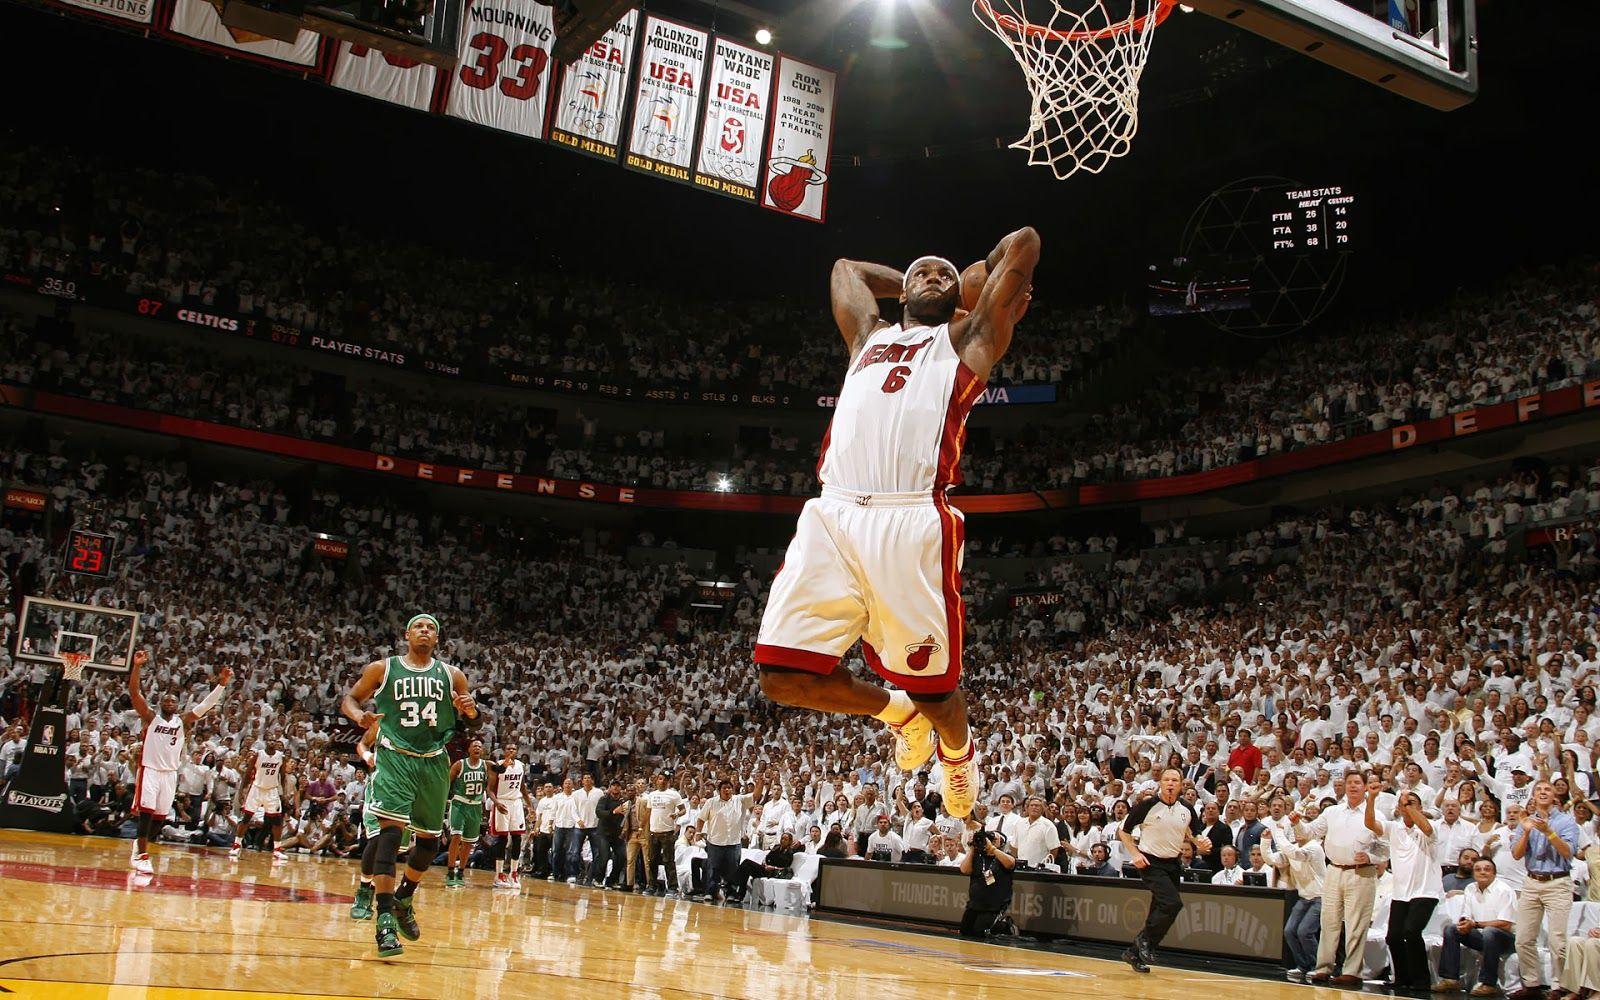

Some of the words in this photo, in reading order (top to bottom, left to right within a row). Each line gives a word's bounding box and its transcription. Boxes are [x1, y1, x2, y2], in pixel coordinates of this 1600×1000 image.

[471, 7, 552, 41] MOURNING
[655, 25, 698, 46] ALONZO
[648, 35, 702, 61] MOURNING
[717, 44, 770, 70] DWYANE
[460, 32, 548, 100] 33
[650, 62, 693, 89] USA
[724, 59, 761, 80] WADE
[792, 80, 821, 95] CULP
[795, 72, 820, 86] RON
[661, 81, 697, 98] BASKETBALL
[718, 83, 760, 109] USA
[726, 104, 763, 121] BASKETBALL
[781, 112, 823, 130] ATHLETIC
[793, 106, 815, 118] HEAD
[780, 121, 822, 139] TRAINER
[552, 131, 577, 147] GOLD
[581, 140, 617, 158] MEDAL
[628, 156, 653, 170] GOLD
[654, 163, 690, 180] MEDAL
[695, 174, 721, 190] GOLD
[722, 183, 755, 199] MEDAL
[1286, 191, 1311, 200] TEAM
[1313, 187, 1341, 197] STATS
[1299, 198, 1323, 208] HEAT
[1328, 196, 1354, 204] CELTICS
[1272, 212, 1292, 221] FTM
[1306, 210, 1316, 218] 26
[1335, 207, 1346, 215] 14
[1273, 227, 1291, 235] FTA
[1306, 224, 1317, 232] 38
[1336, 221, 1347, 229] 20
[1274, 240, 1294, 249] FT%
[1337, 235, 1348, 243] 70
[136, 298, 163, 317] 87
[177, 309, 239, 332] CELTICS
[310, 335, 362, 355] PLAYER
[364, 348, 405, 365] STATS
[510, 373, 529, 384] MIN
[554, 379, 572, 389] PTS
[644, 390, 676, 400] ASSTS
[702, 392, 725, 401] STLS
[751, 395, 775, 404] BLKS
[881, 366, 911, 393] 6
[7, 494, 45, 506] BACARDI
[71, 548, 103, 572] 23
[394, 676, 444, 701] CELTICS
[400, 701, 438, 727] 34
[155, 725, 181, 735] HEAT
[34, 746, 48, 754] NBA
[49, 747, 58, 755] TV
[170, 737, 176, 746] 3
[505, 771, 523, 780] HEAT
[466, 783, 483, 795] 20
[16, 794, 64, 809] PLAYOFFS
[891, 881, 948, 907] THUNDER
[1012, 892, 1045, 920] LIES
[1052, 896, 1094, 921] NEXT
[1099, 902, 1117, 924] ON
[1177, 900, 1268, 956] MEMPHIS
